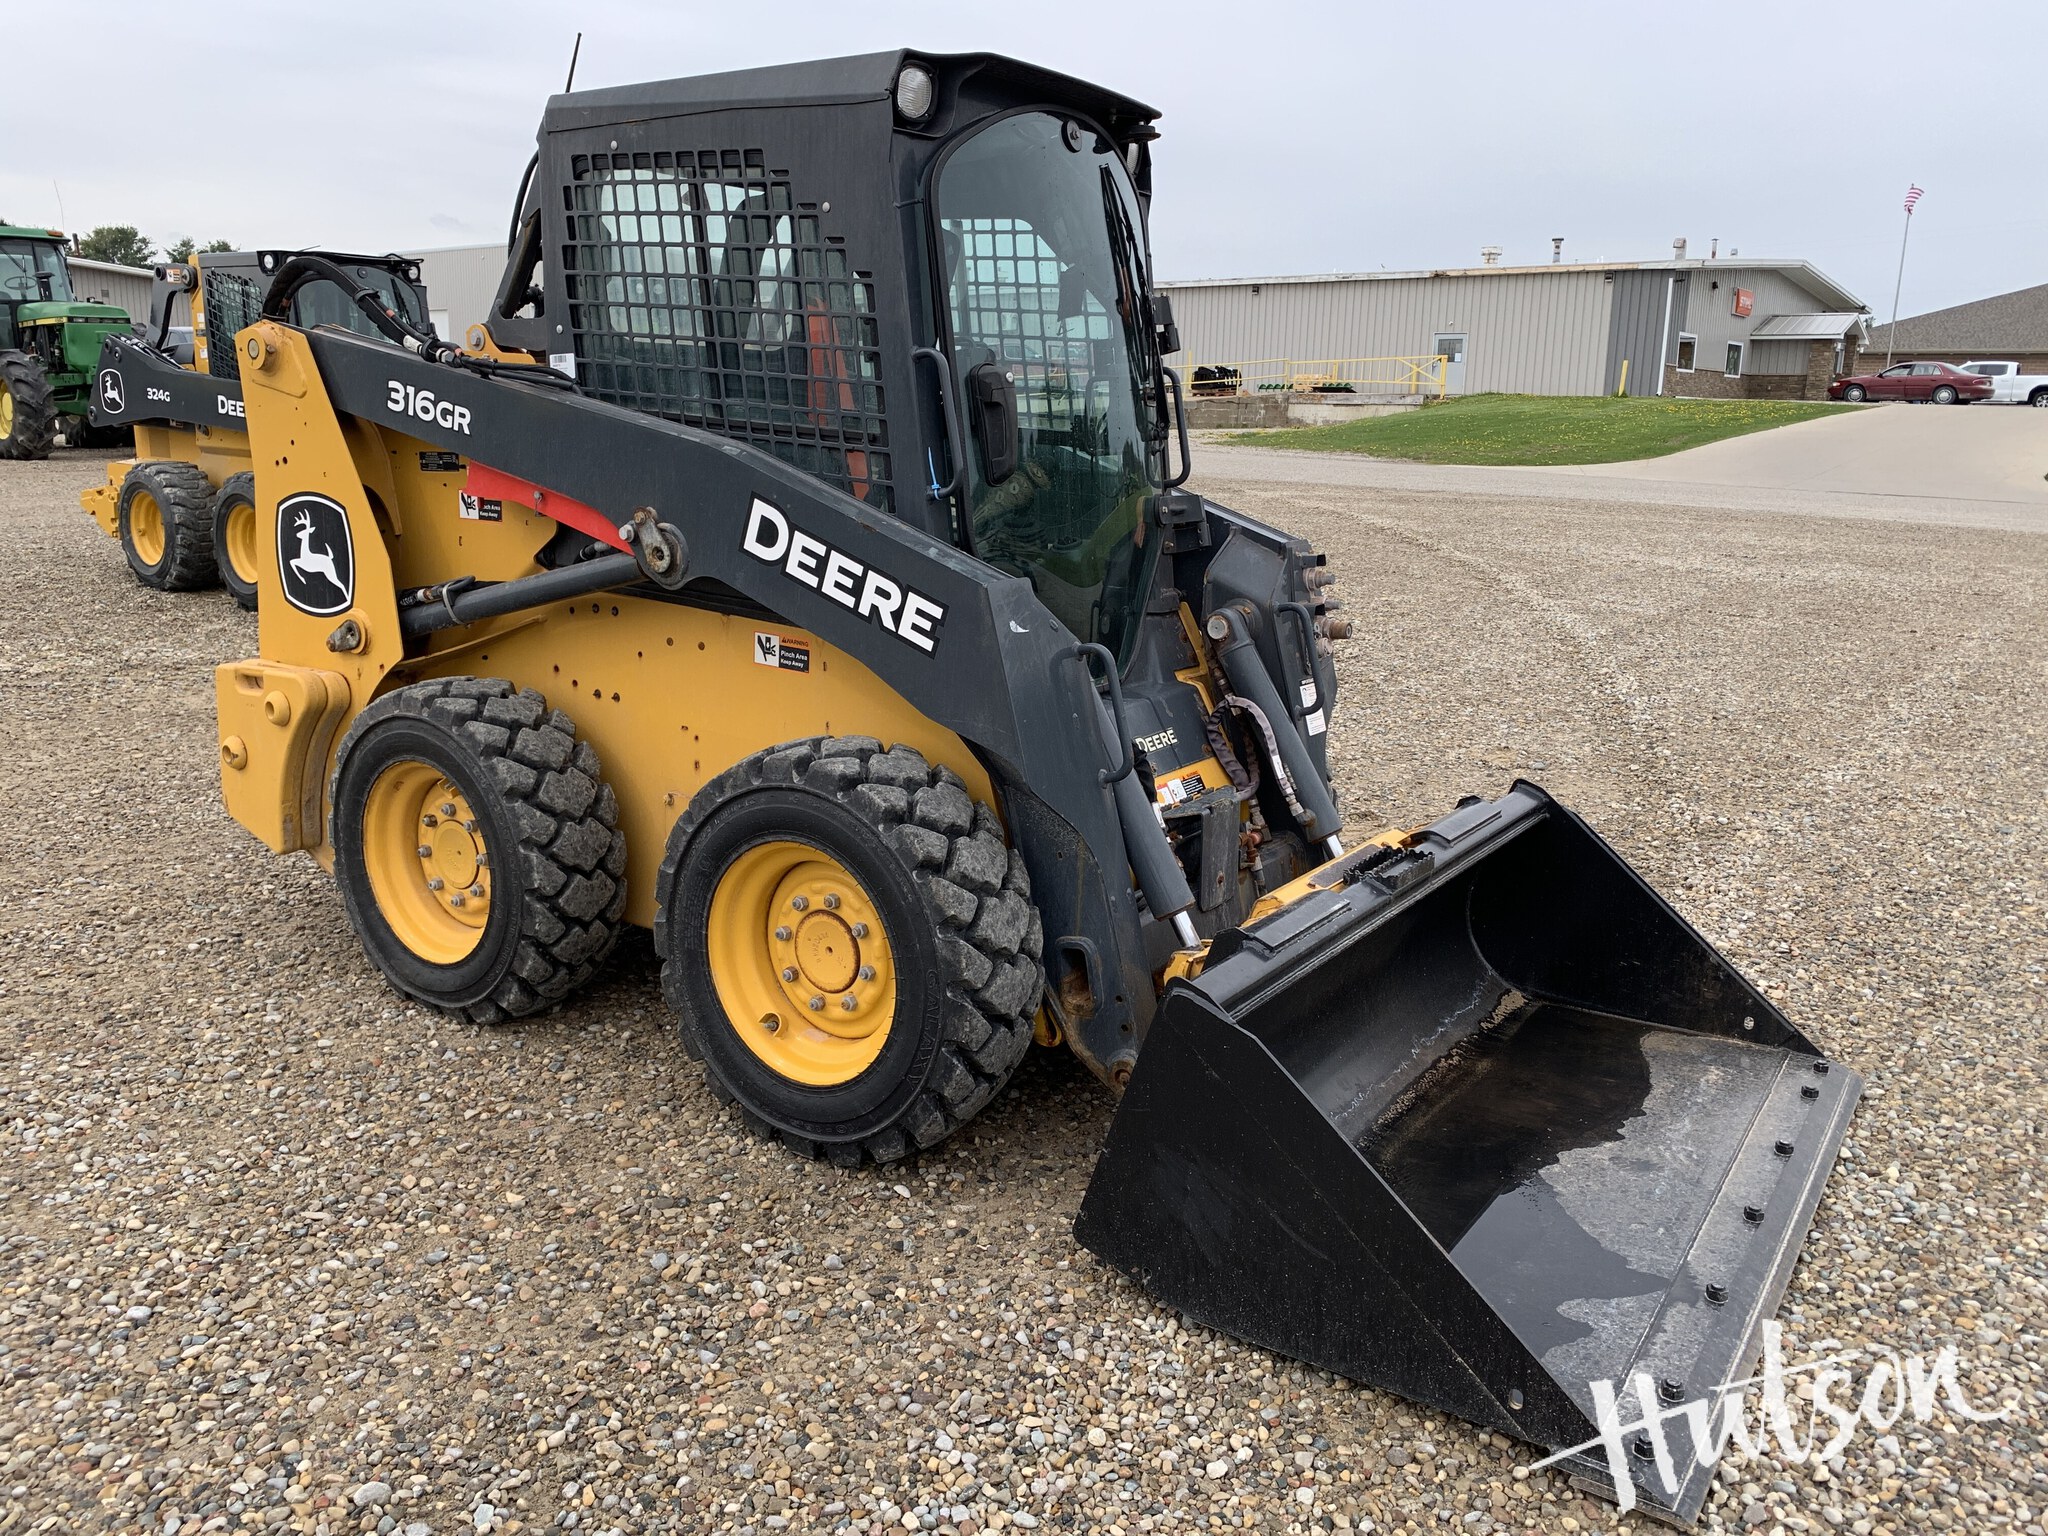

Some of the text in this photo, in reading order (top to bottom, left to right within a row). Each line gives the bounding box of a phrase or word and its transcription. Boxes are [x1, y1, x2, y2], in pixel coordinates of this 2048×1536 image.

[146, 387, 171, 403] 324G
[217, 394, 246, 418] DEE
[387, 380, 472, 435] 316GR
[743, 498, 944, 652] DEERE
[780, 650, 808, 661] Pinch Area
[780, 658, 804, 669] Keep Away
[1134, 729, 1178, 753] DEERE
[906, 968, 940, 1091] GALAXY
